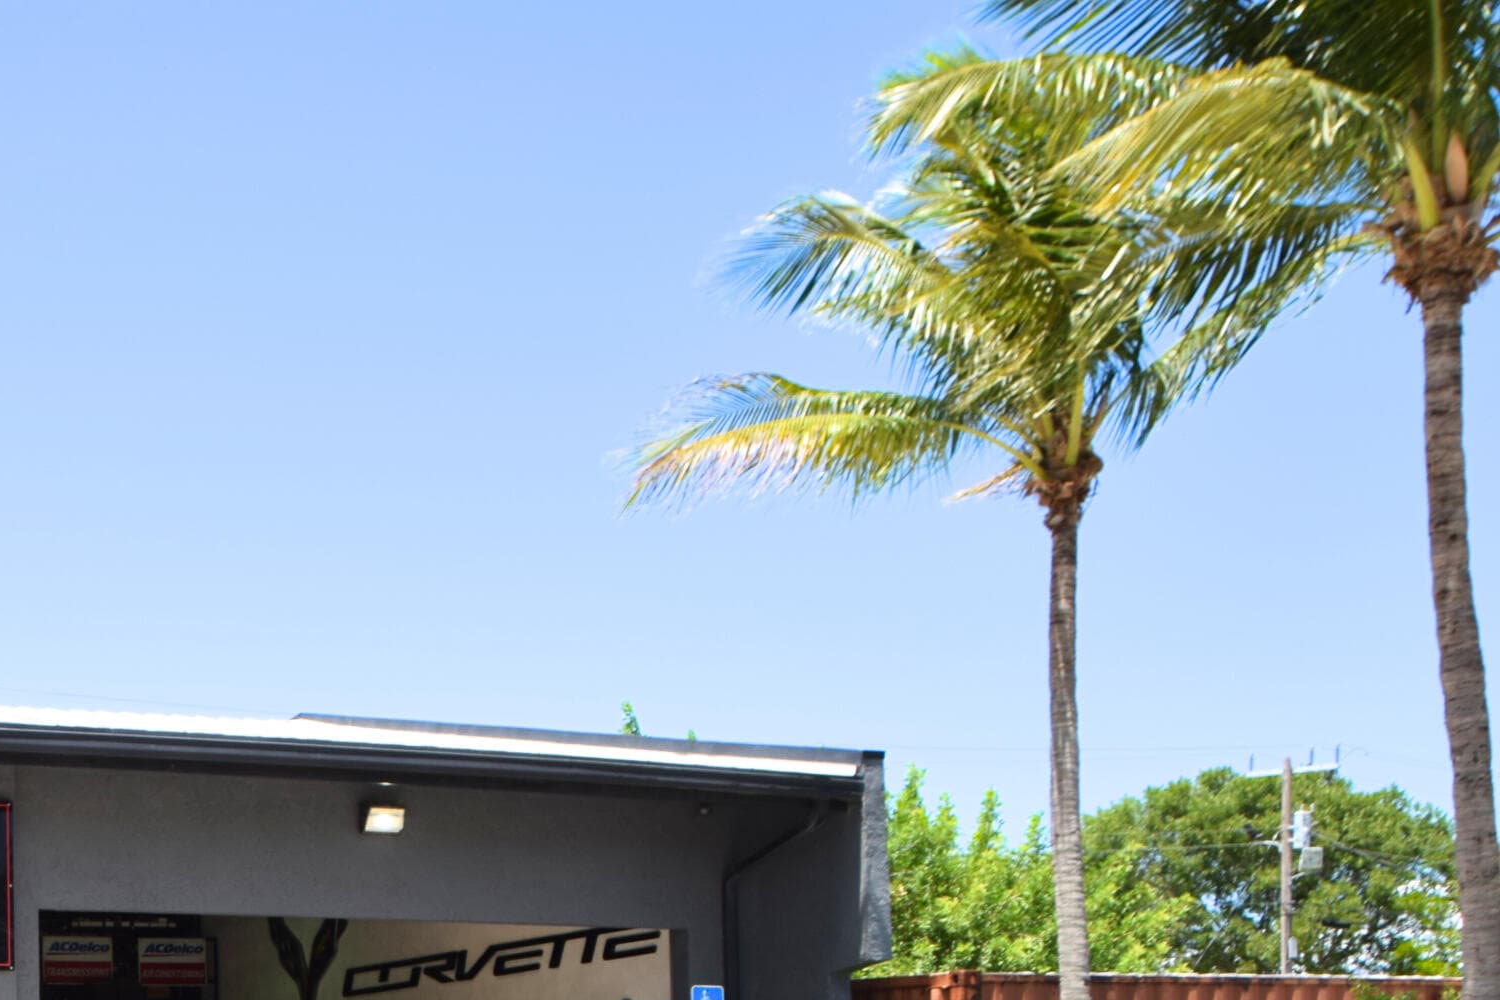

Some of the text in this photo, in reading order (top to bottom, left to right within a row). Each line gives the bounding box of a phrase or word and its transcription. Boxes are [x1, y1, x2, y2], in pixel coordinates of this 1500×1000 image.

[49, 941, 110, 953] ACDelco
[144, 943, 203, 954] ACDelco
[341, 927, 661, 997] CORVETTE
